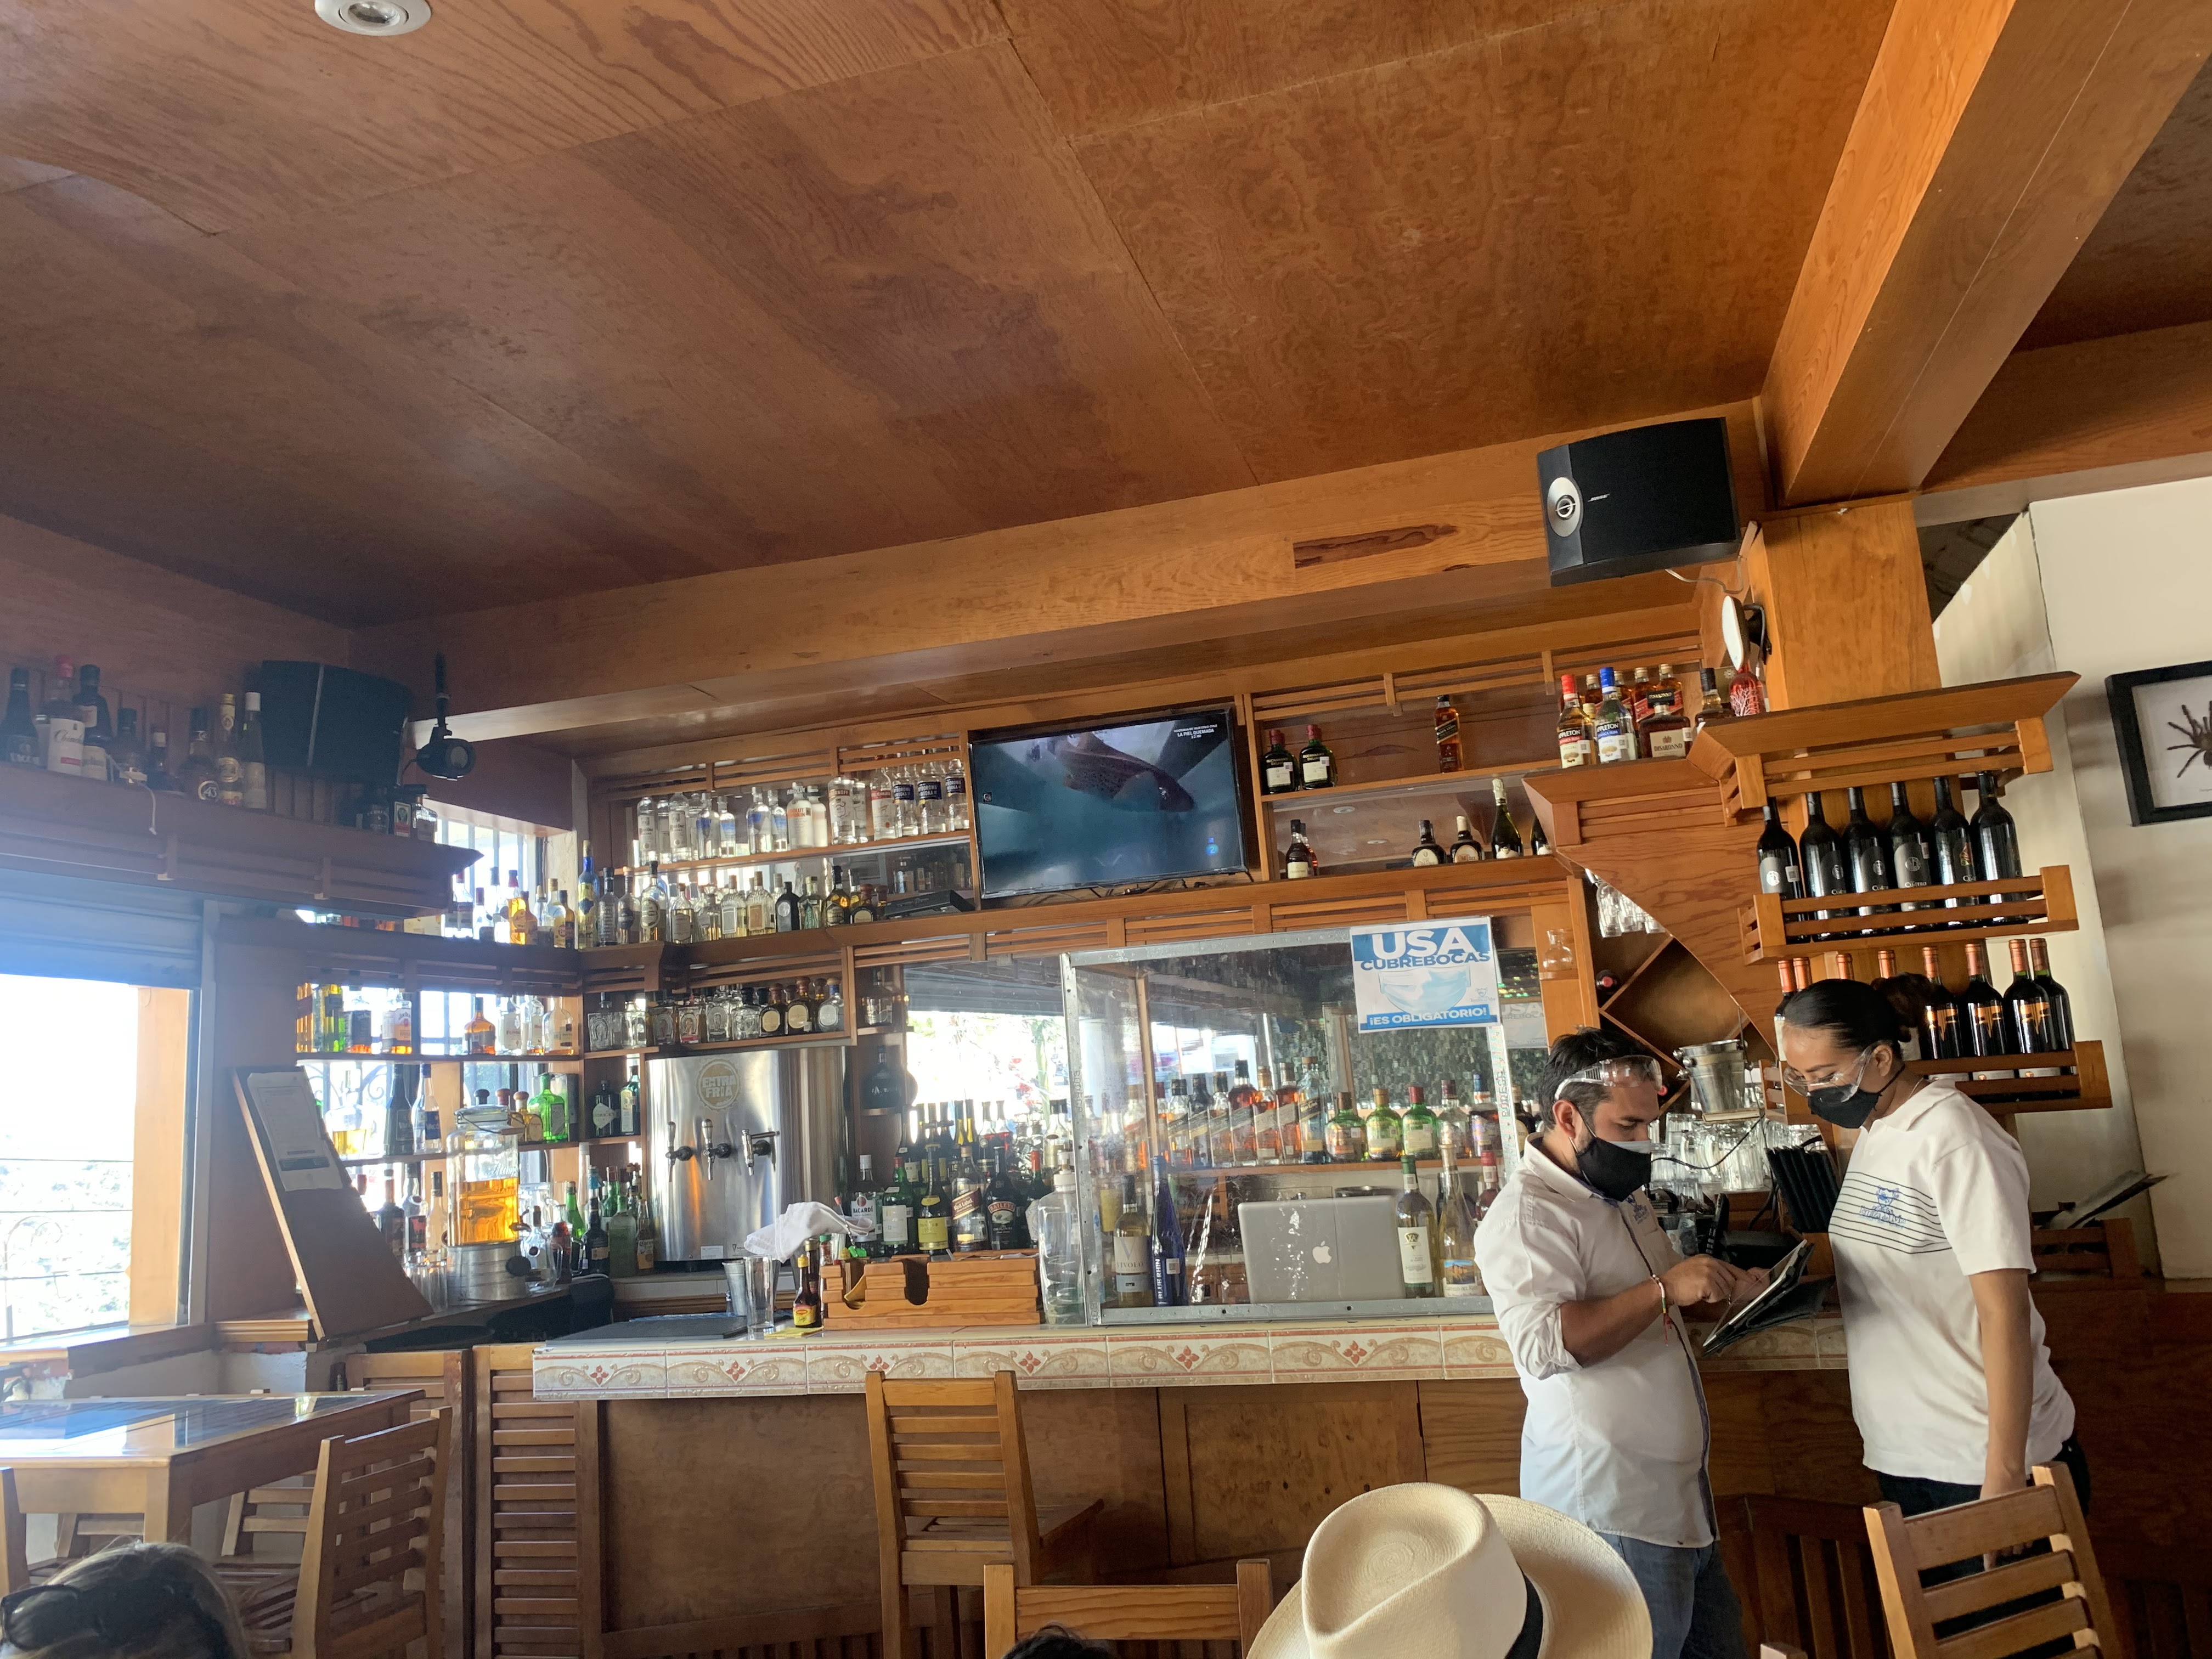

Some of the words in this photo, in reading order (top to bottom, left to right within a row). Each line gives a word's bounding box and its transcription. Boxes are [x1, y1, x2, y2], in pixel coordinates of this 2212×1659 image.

[204, 787, 217, 798] 43
[1372, 927, 1476, 960] USA
[1361, 951, 1491, 970] CUBREBOCAS
[1370, 1015, 1389, 1025] ¡ES
[1392, 1007, 1487, 1024] OBLIGATORIO!
[953, 1202, 962, 1211] Red
[962, 1198, 973, 1207] Label
[989, 1202, 1014, 1211] BAILEYS
